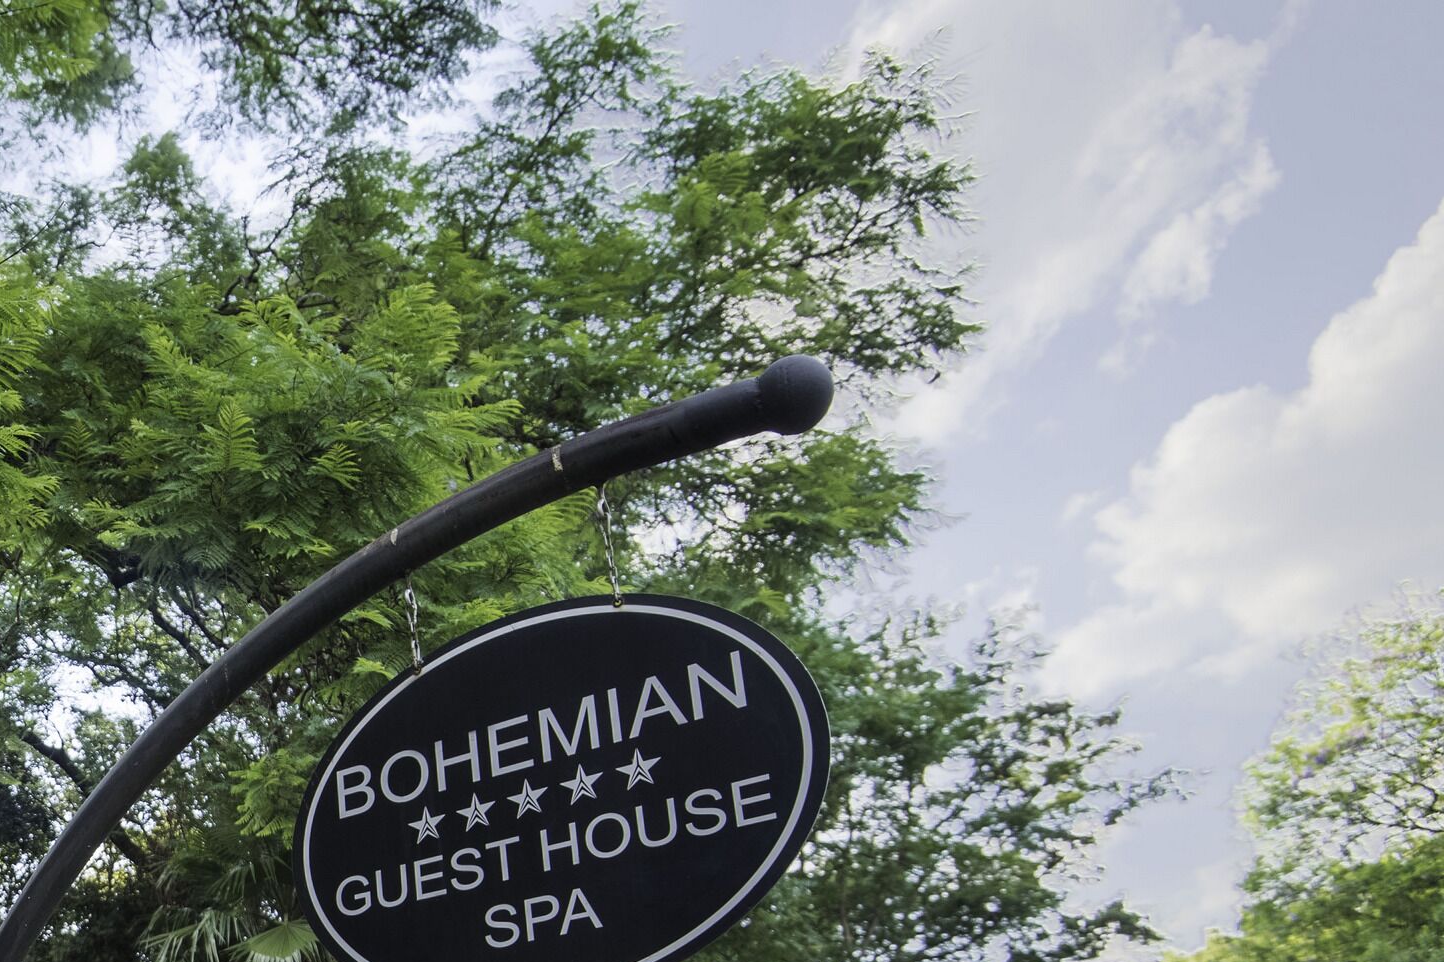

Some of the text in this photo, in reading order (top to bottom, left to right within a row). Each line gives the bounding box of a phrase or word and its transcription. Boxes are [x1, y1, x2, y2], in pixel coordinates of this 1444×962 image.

[335, 650, 748, 820] BOHEMIAN
[335, 773, 778, 918] GUEST HOUSE
[484, 888, 603, 949] SPA
